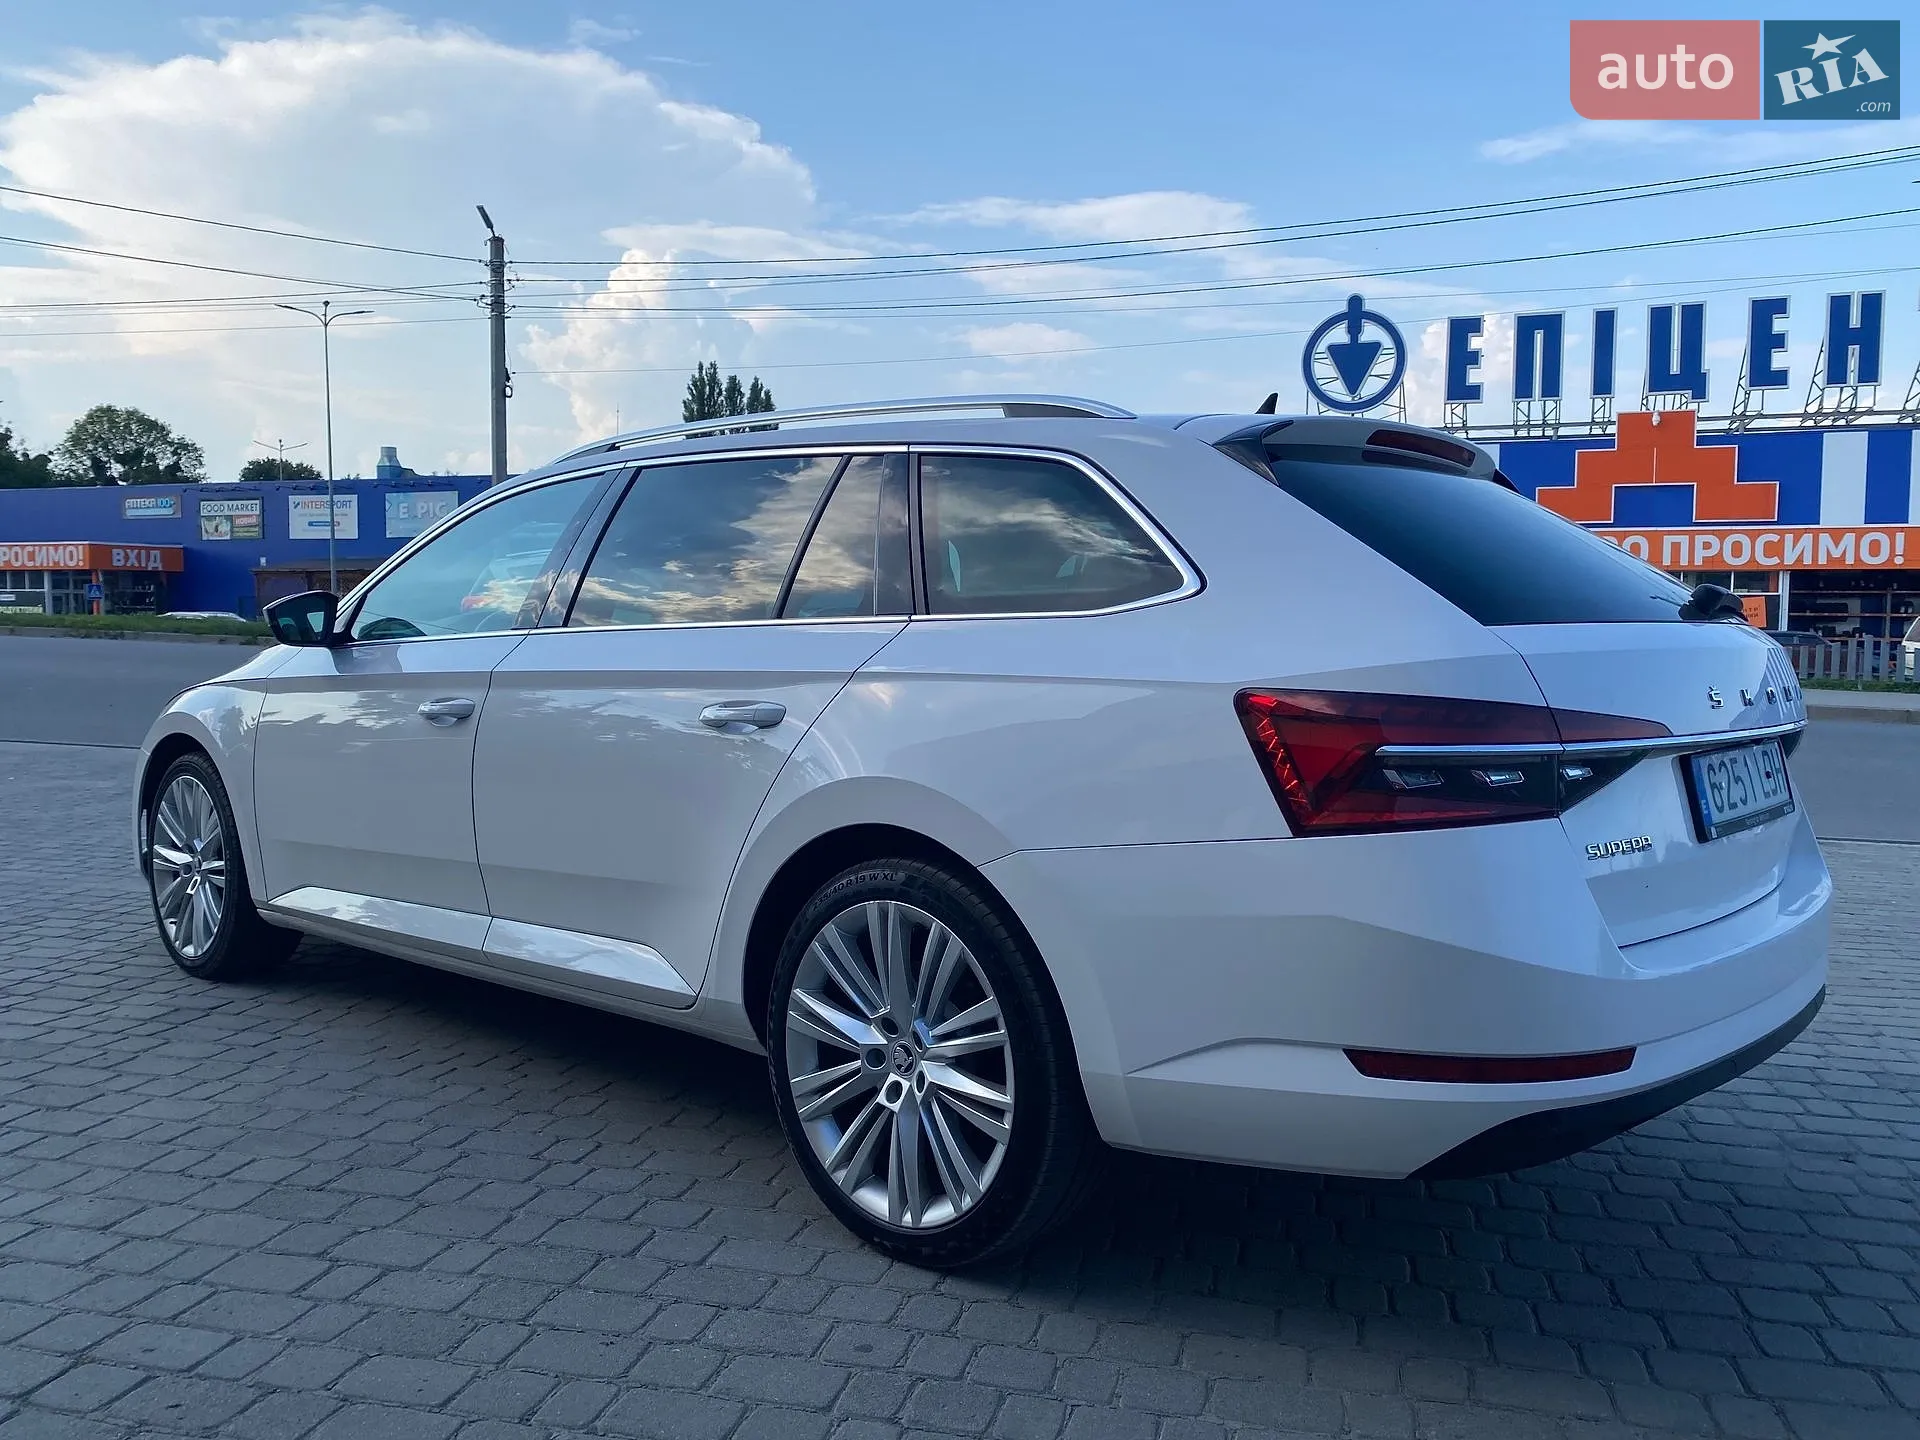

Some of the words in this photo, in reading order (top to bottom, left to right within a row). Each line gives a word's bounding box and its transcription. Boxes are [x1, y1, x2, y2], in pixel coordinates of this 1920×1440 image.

[201, 503, 224, 518] FOOD
[226, 502, 258, 517] MARKET
[300, 500, 353, 509] INTERSPORT
[112, 548, 163, 571] ВХІД
[1662, 531, 1906, 567] ПРОСИМО!
[1707, 755, 1758, 814] 6251
[1585, 834, 1653, 861] SUPERB
[881, 871, 896, 882] XL
